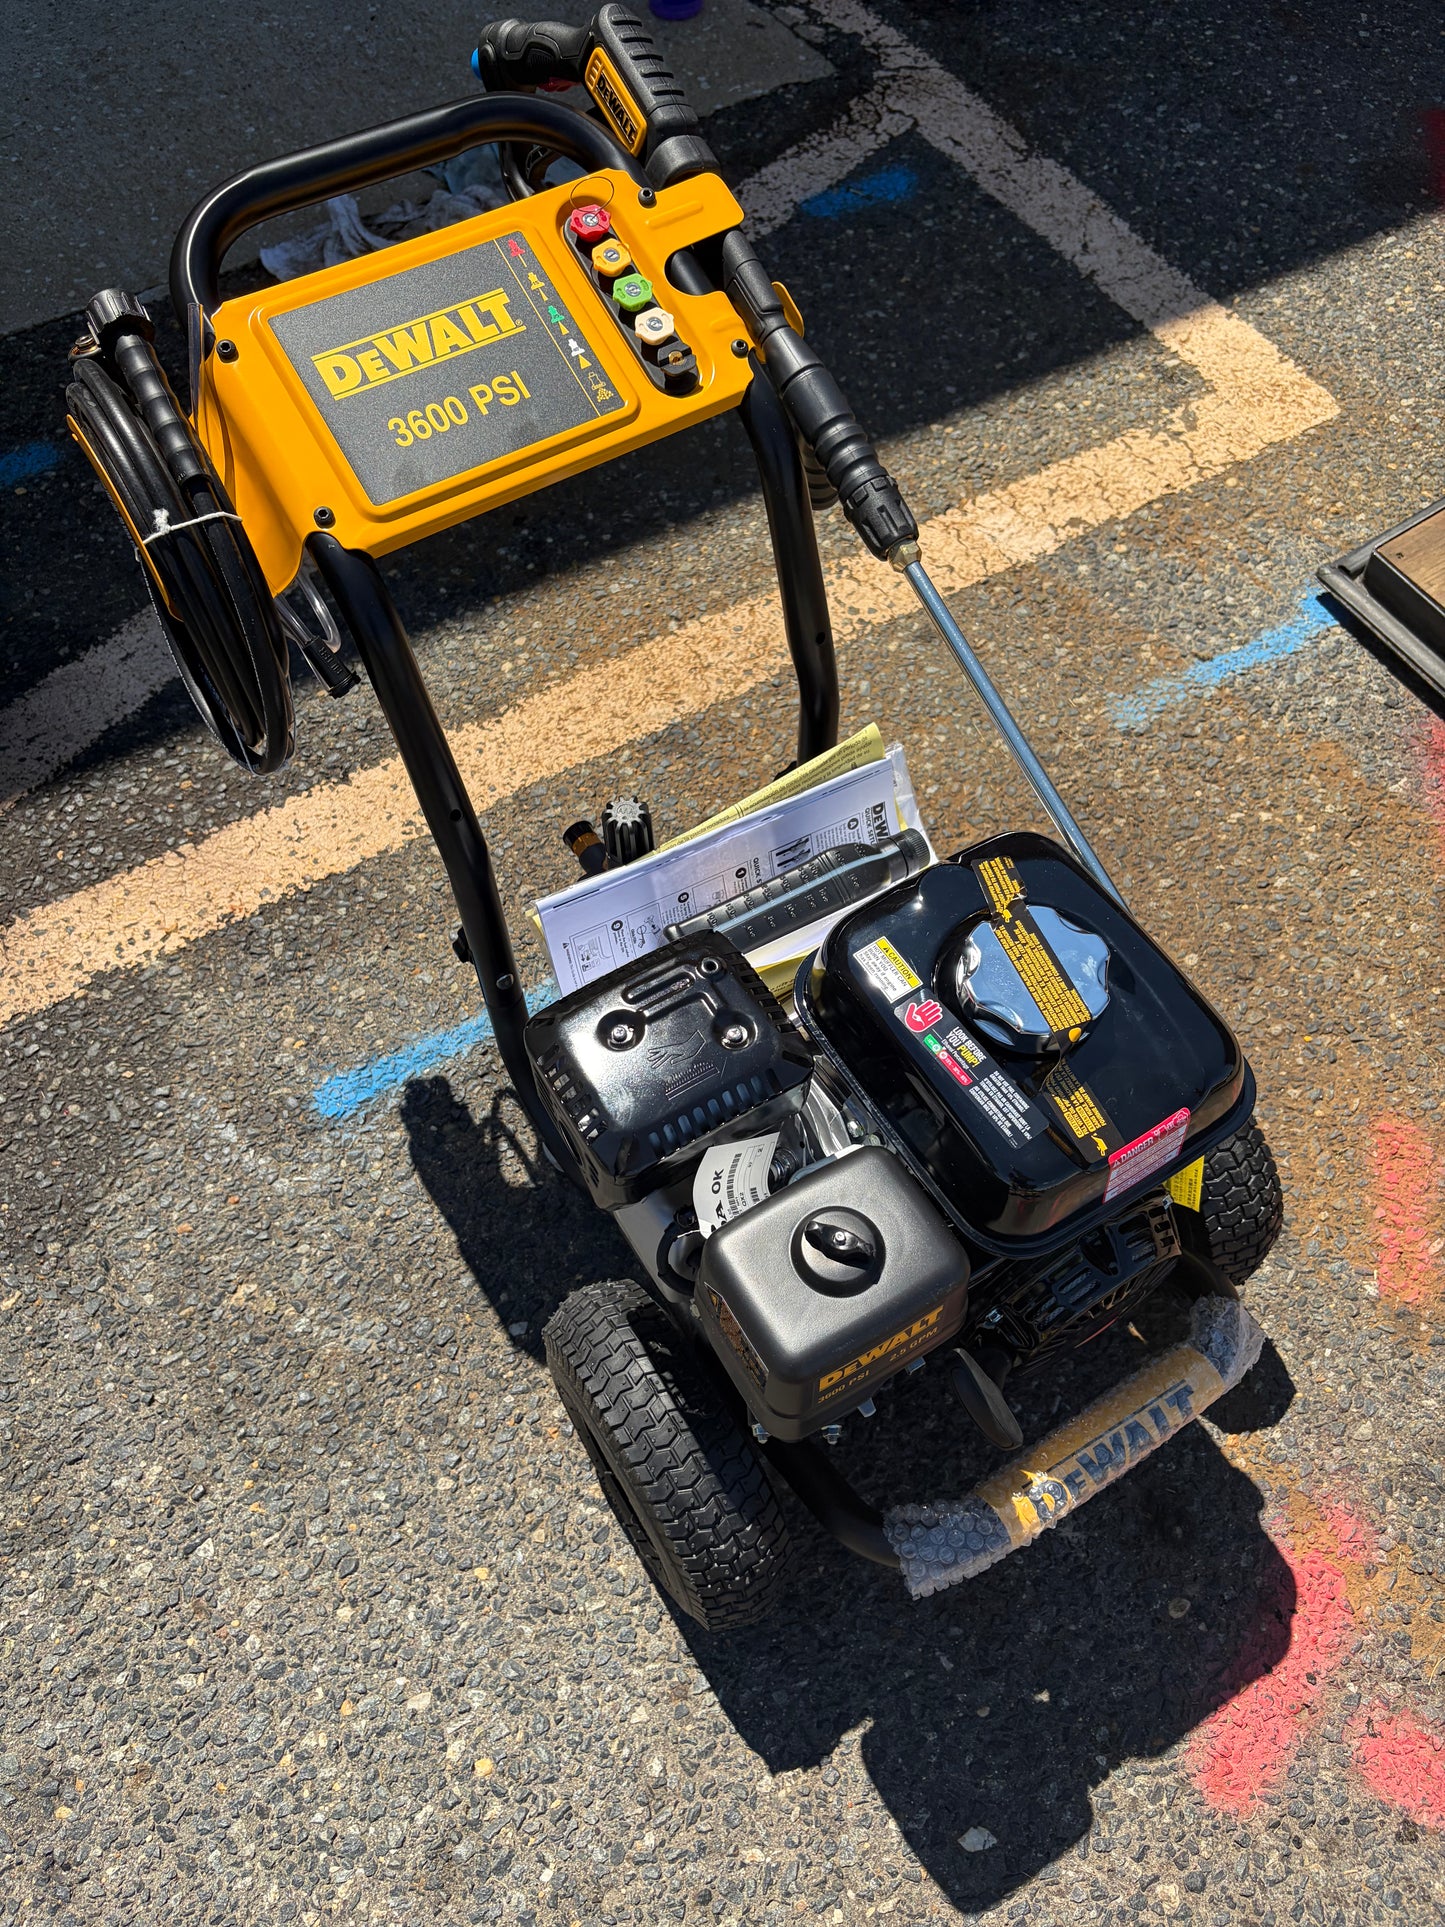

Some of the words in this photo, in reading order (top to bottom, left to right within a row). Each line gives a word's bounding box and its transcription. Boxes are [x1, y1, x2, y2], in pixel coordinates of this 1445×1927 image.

[388, 396, 469, 447] 3600
[468, 370, 531, 416] PSI
[867, 829, 875, 845] SETU
[871, 802, 889, 841] DEW
[752, 857, 760, 878] QUICK
[888, 951, 912, 981] CAUTION
[945, 1030, 961, 1047] YOU
[956, 1044, 980, 1068] PUMP!
[952, 1025, 968, 1042] LOOK
[964, 1039, 986, 1062] BEFORE
[1119, 1136, 1154, 1162] DANGER
[709, 1166, 724, 1194] OK
[815, 1383, 845, 1404] 3600
[847, 1368, 871, 1387] PSI
[908, 1325, 939, 1350] GPM
